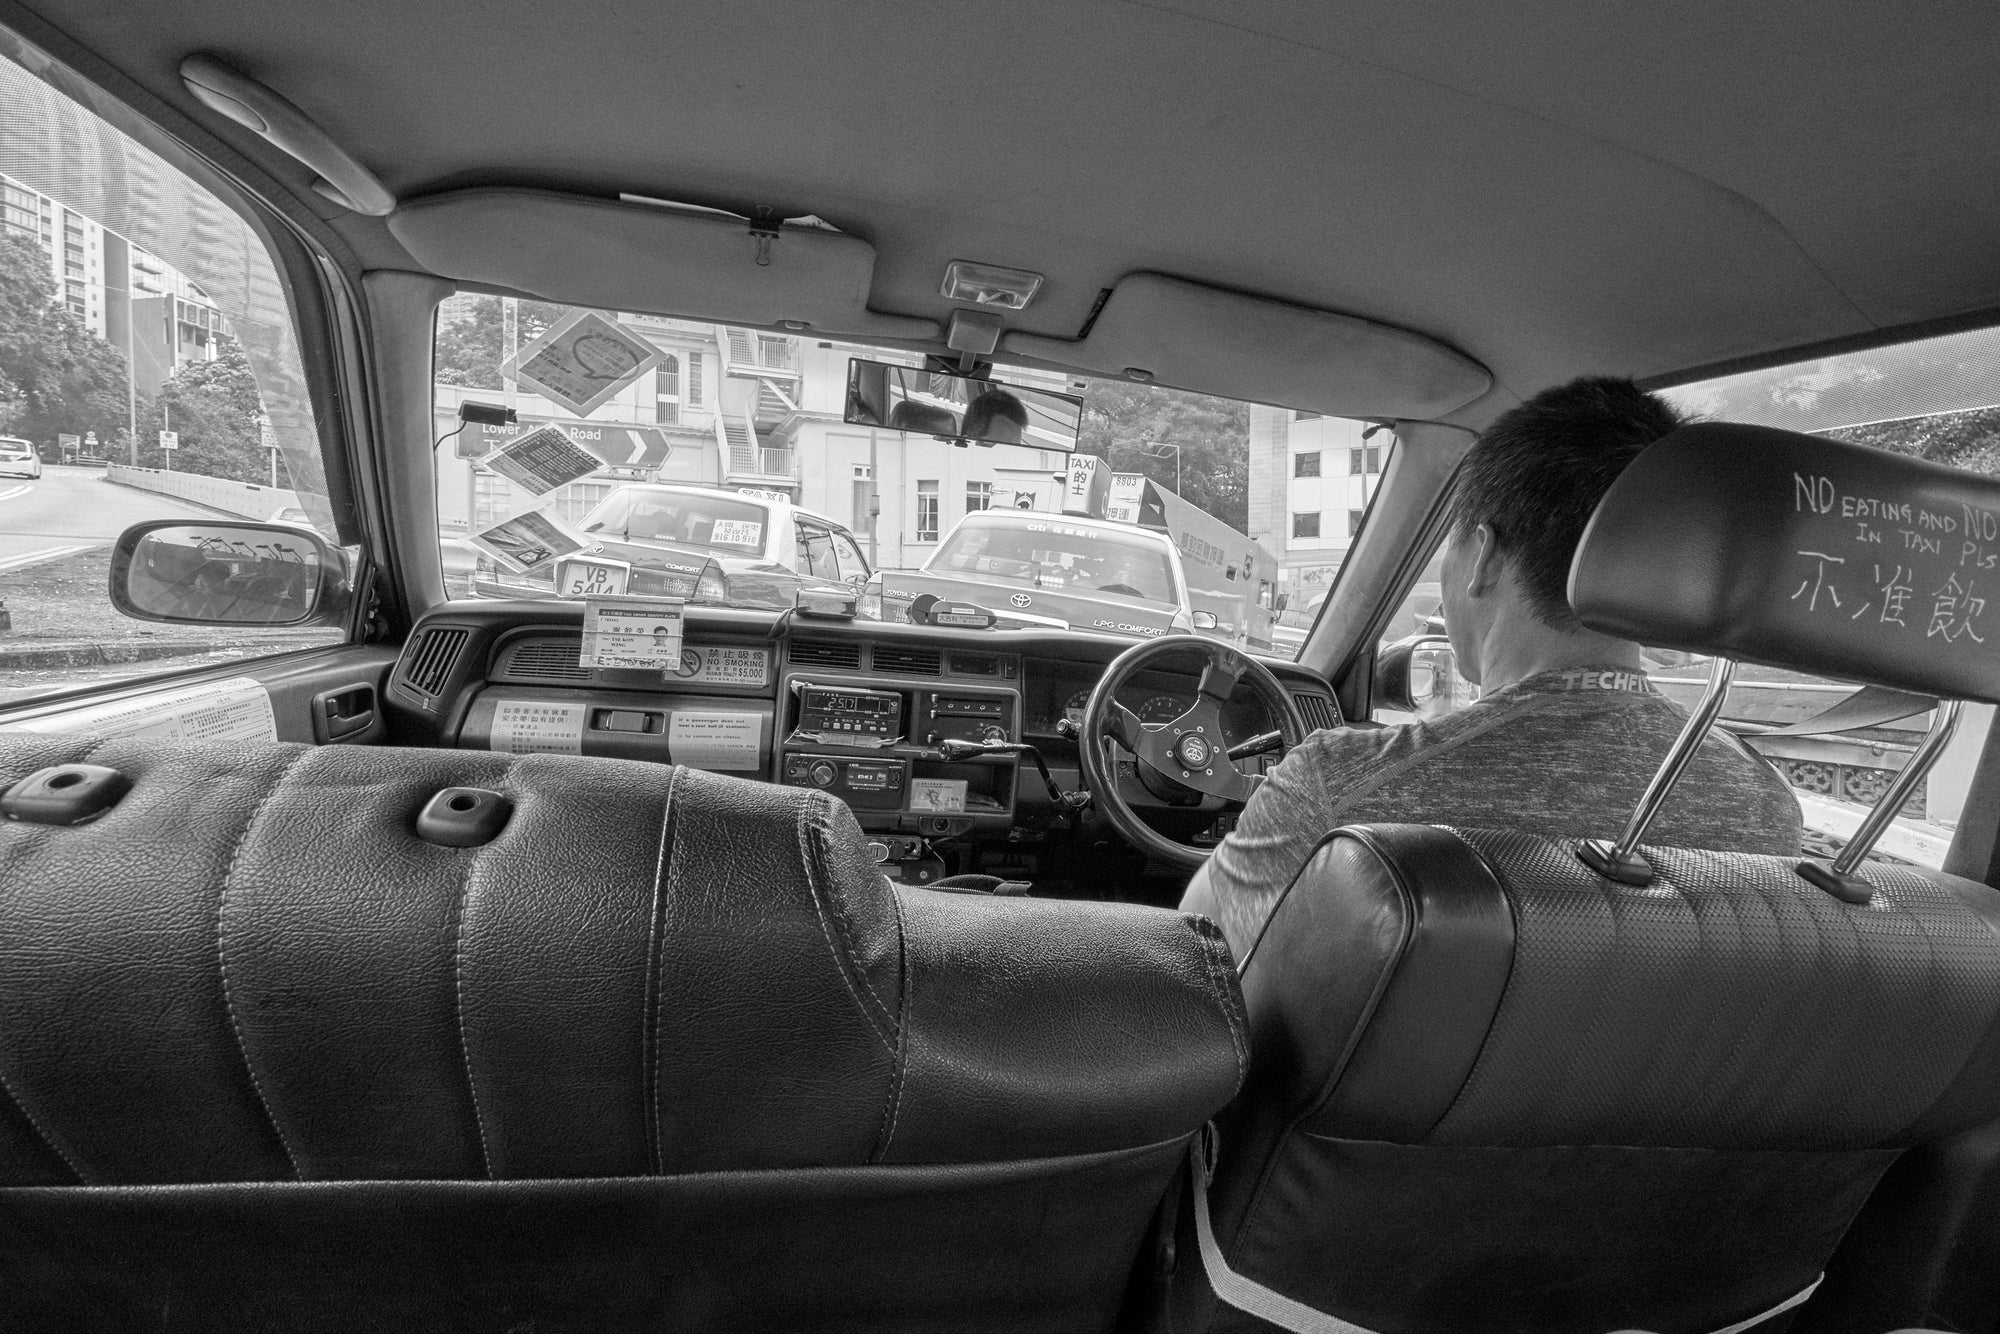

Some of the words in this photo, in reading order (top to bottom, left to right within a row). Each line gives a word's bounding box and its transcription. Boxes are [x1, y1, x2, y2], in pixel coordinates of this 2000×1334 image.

[482, 423, 520, 435] Lower
[570, 427, 602, 440] Road
[1070, 458, 1095, 471] TAXI
[1071, 471, 1087, 496] 的士
[1115, 476, 1137, 487] 8803
[742, 489, 785, 503] TAXI
[1841, 496, 1913, 524] EATING
[1918, 509, 1957, 533] AND
[1961, 503, 1998, 541] NO
[1898, 529, 1941, 555] TAXI
[665, 563, 701, 573] COMFORT
[586, 566, 608, 584] VB
[887, 589, 909, 598] TOYOTA
[1092, 619, 1115, 629] LPG
[1117, 623, 1165, 636] COMFORT
[708, 648, 764, 660] 禁止吸煙
[724, 659, 764, 668] SMOKING
[738, 667, 763, 678] $5,000
